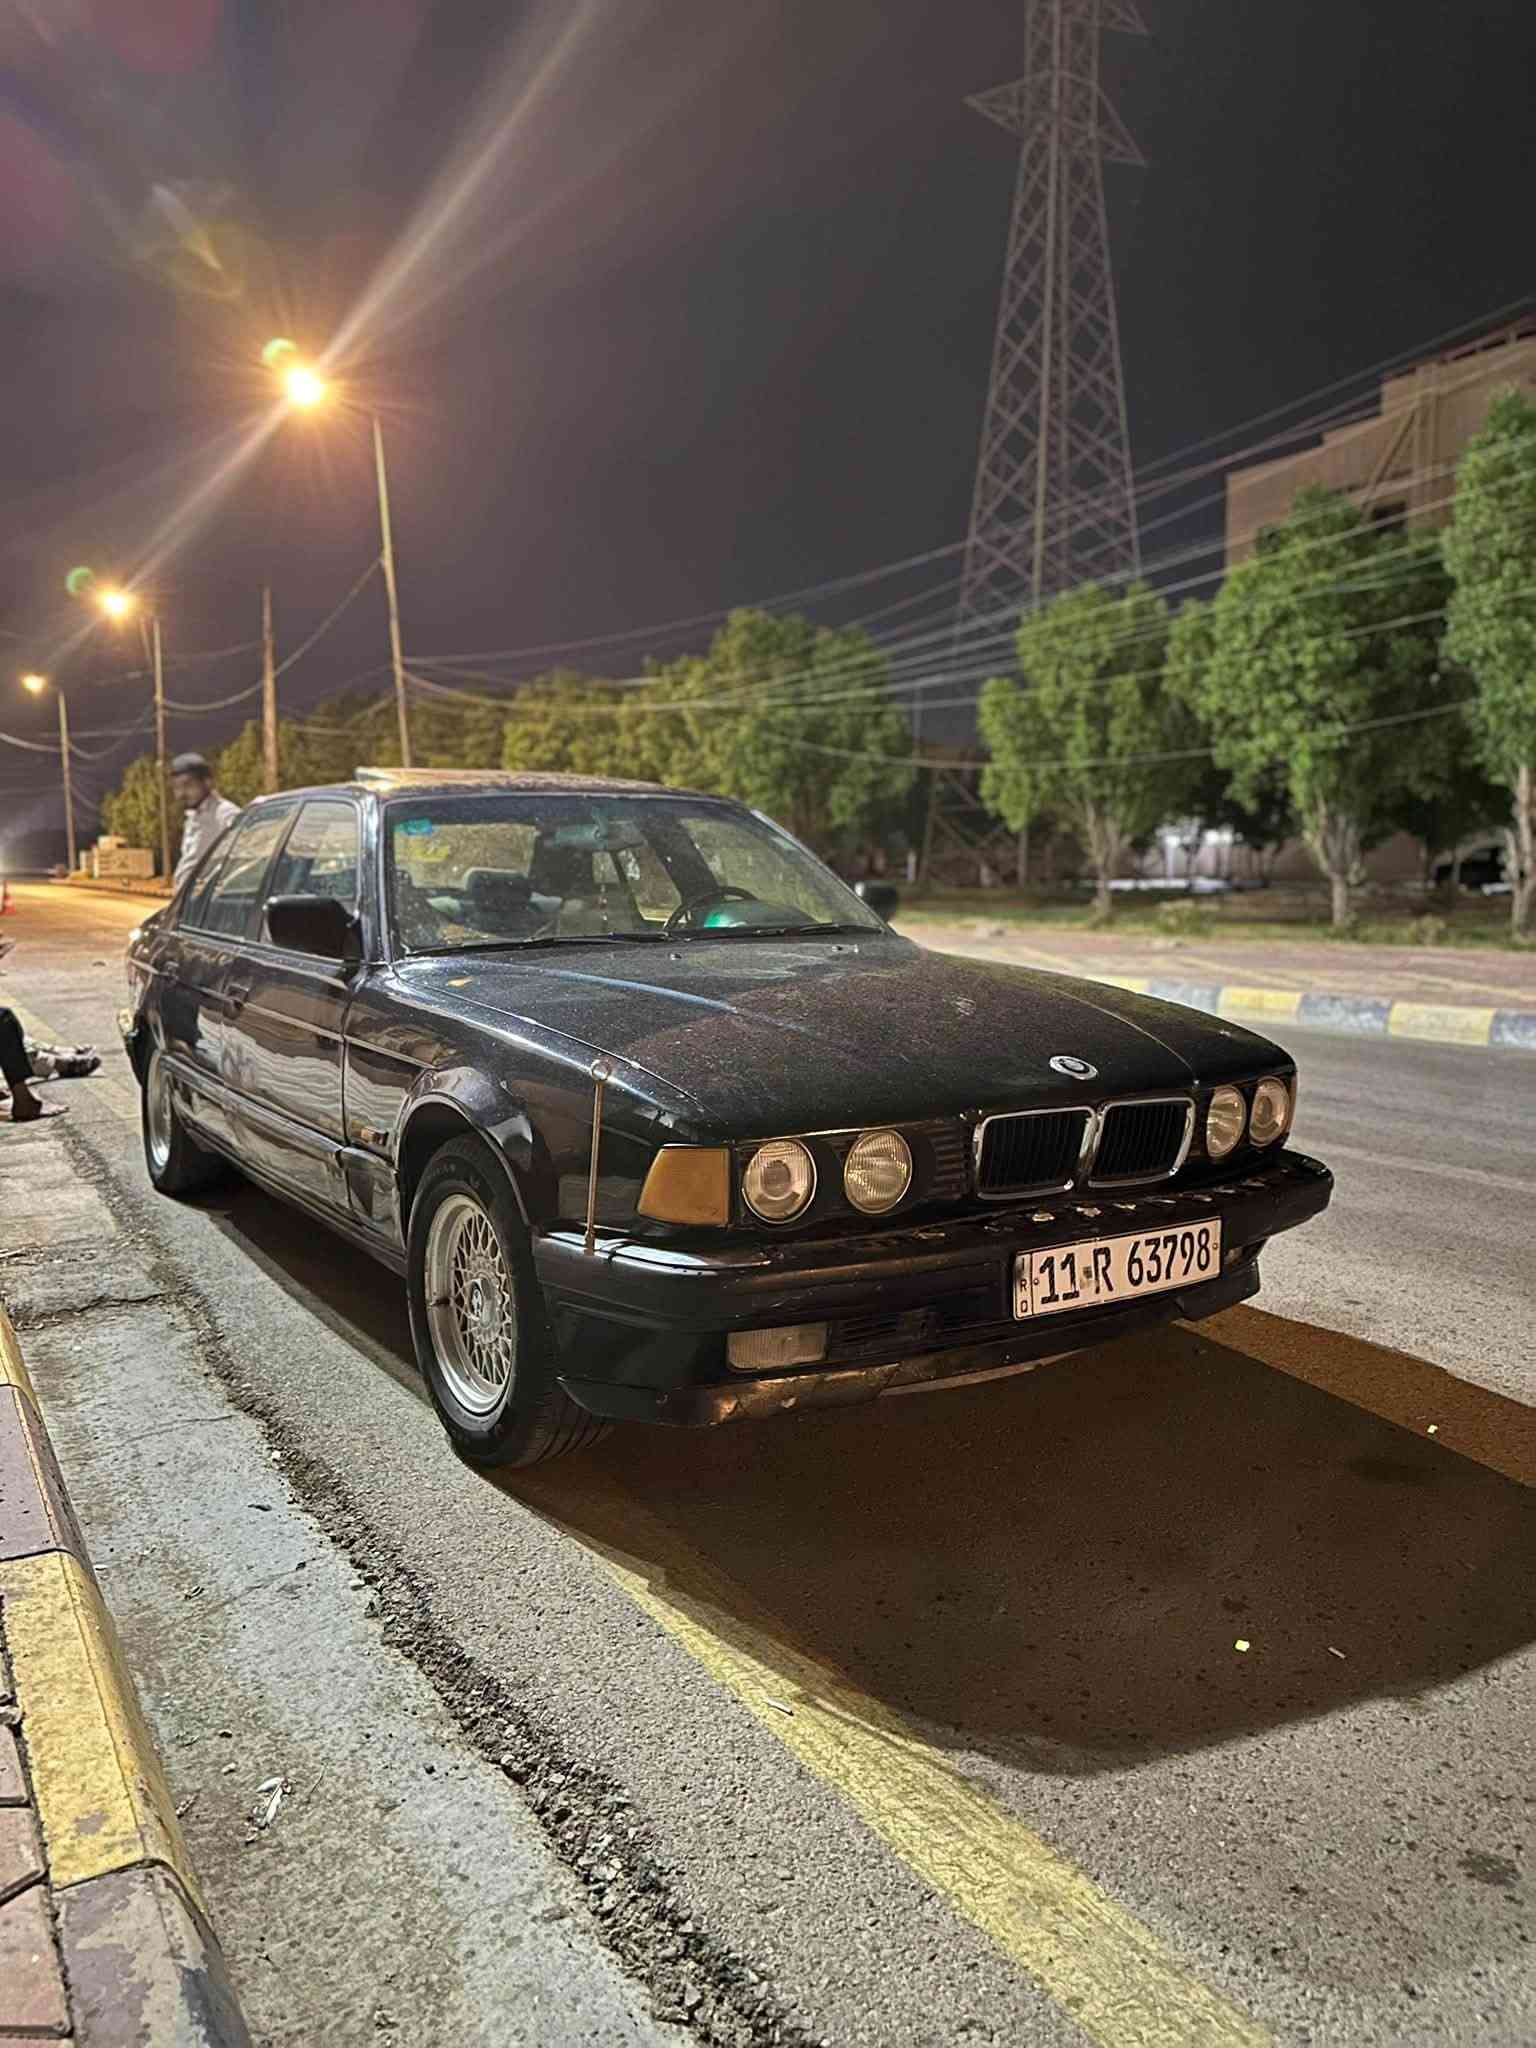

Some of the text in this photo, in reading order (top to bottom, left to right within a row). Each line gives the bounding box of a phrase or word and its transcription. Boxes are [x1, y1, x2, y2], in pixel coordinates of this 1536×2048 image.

[1040, 1228, 1210, 1304] 11 R 63798
